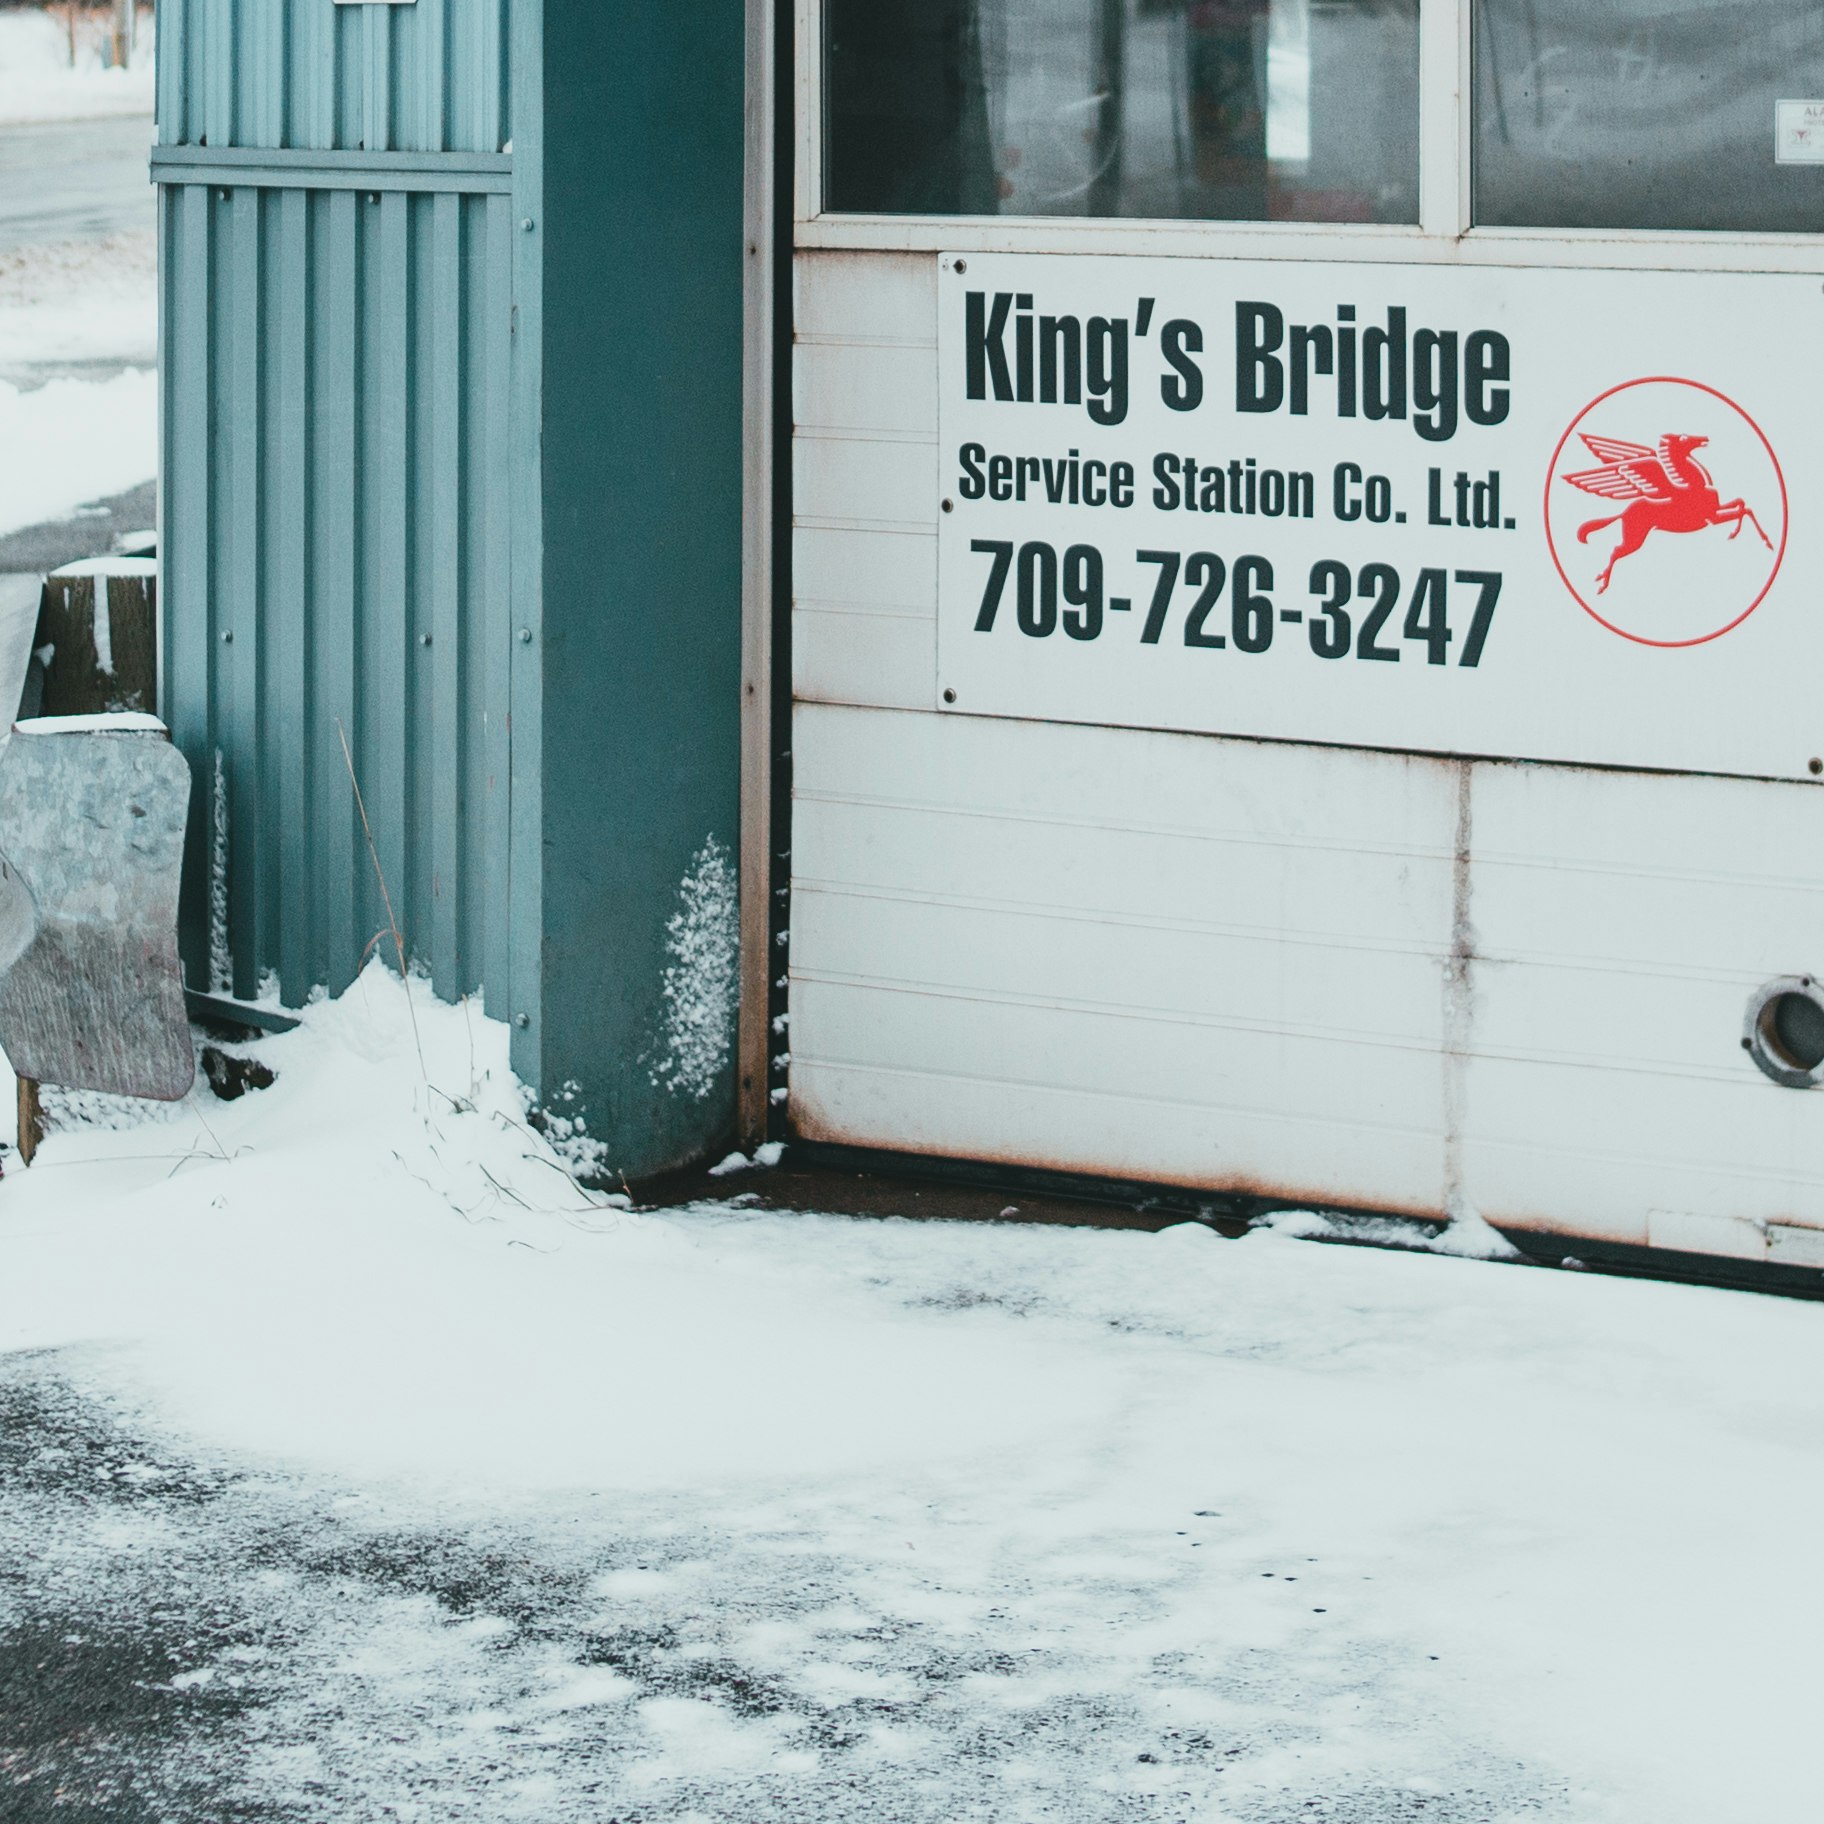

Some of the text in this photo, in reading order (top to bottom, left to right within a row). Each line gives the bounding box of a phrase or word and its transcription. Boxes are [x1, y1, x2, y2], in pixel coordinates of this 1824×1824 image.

[965, 290, 1511, 442] King's Bridge
[958, 442, 1517, 530] Service Station Co. Ltd.
[970, 538, 1503, 668] 709-726-3247
